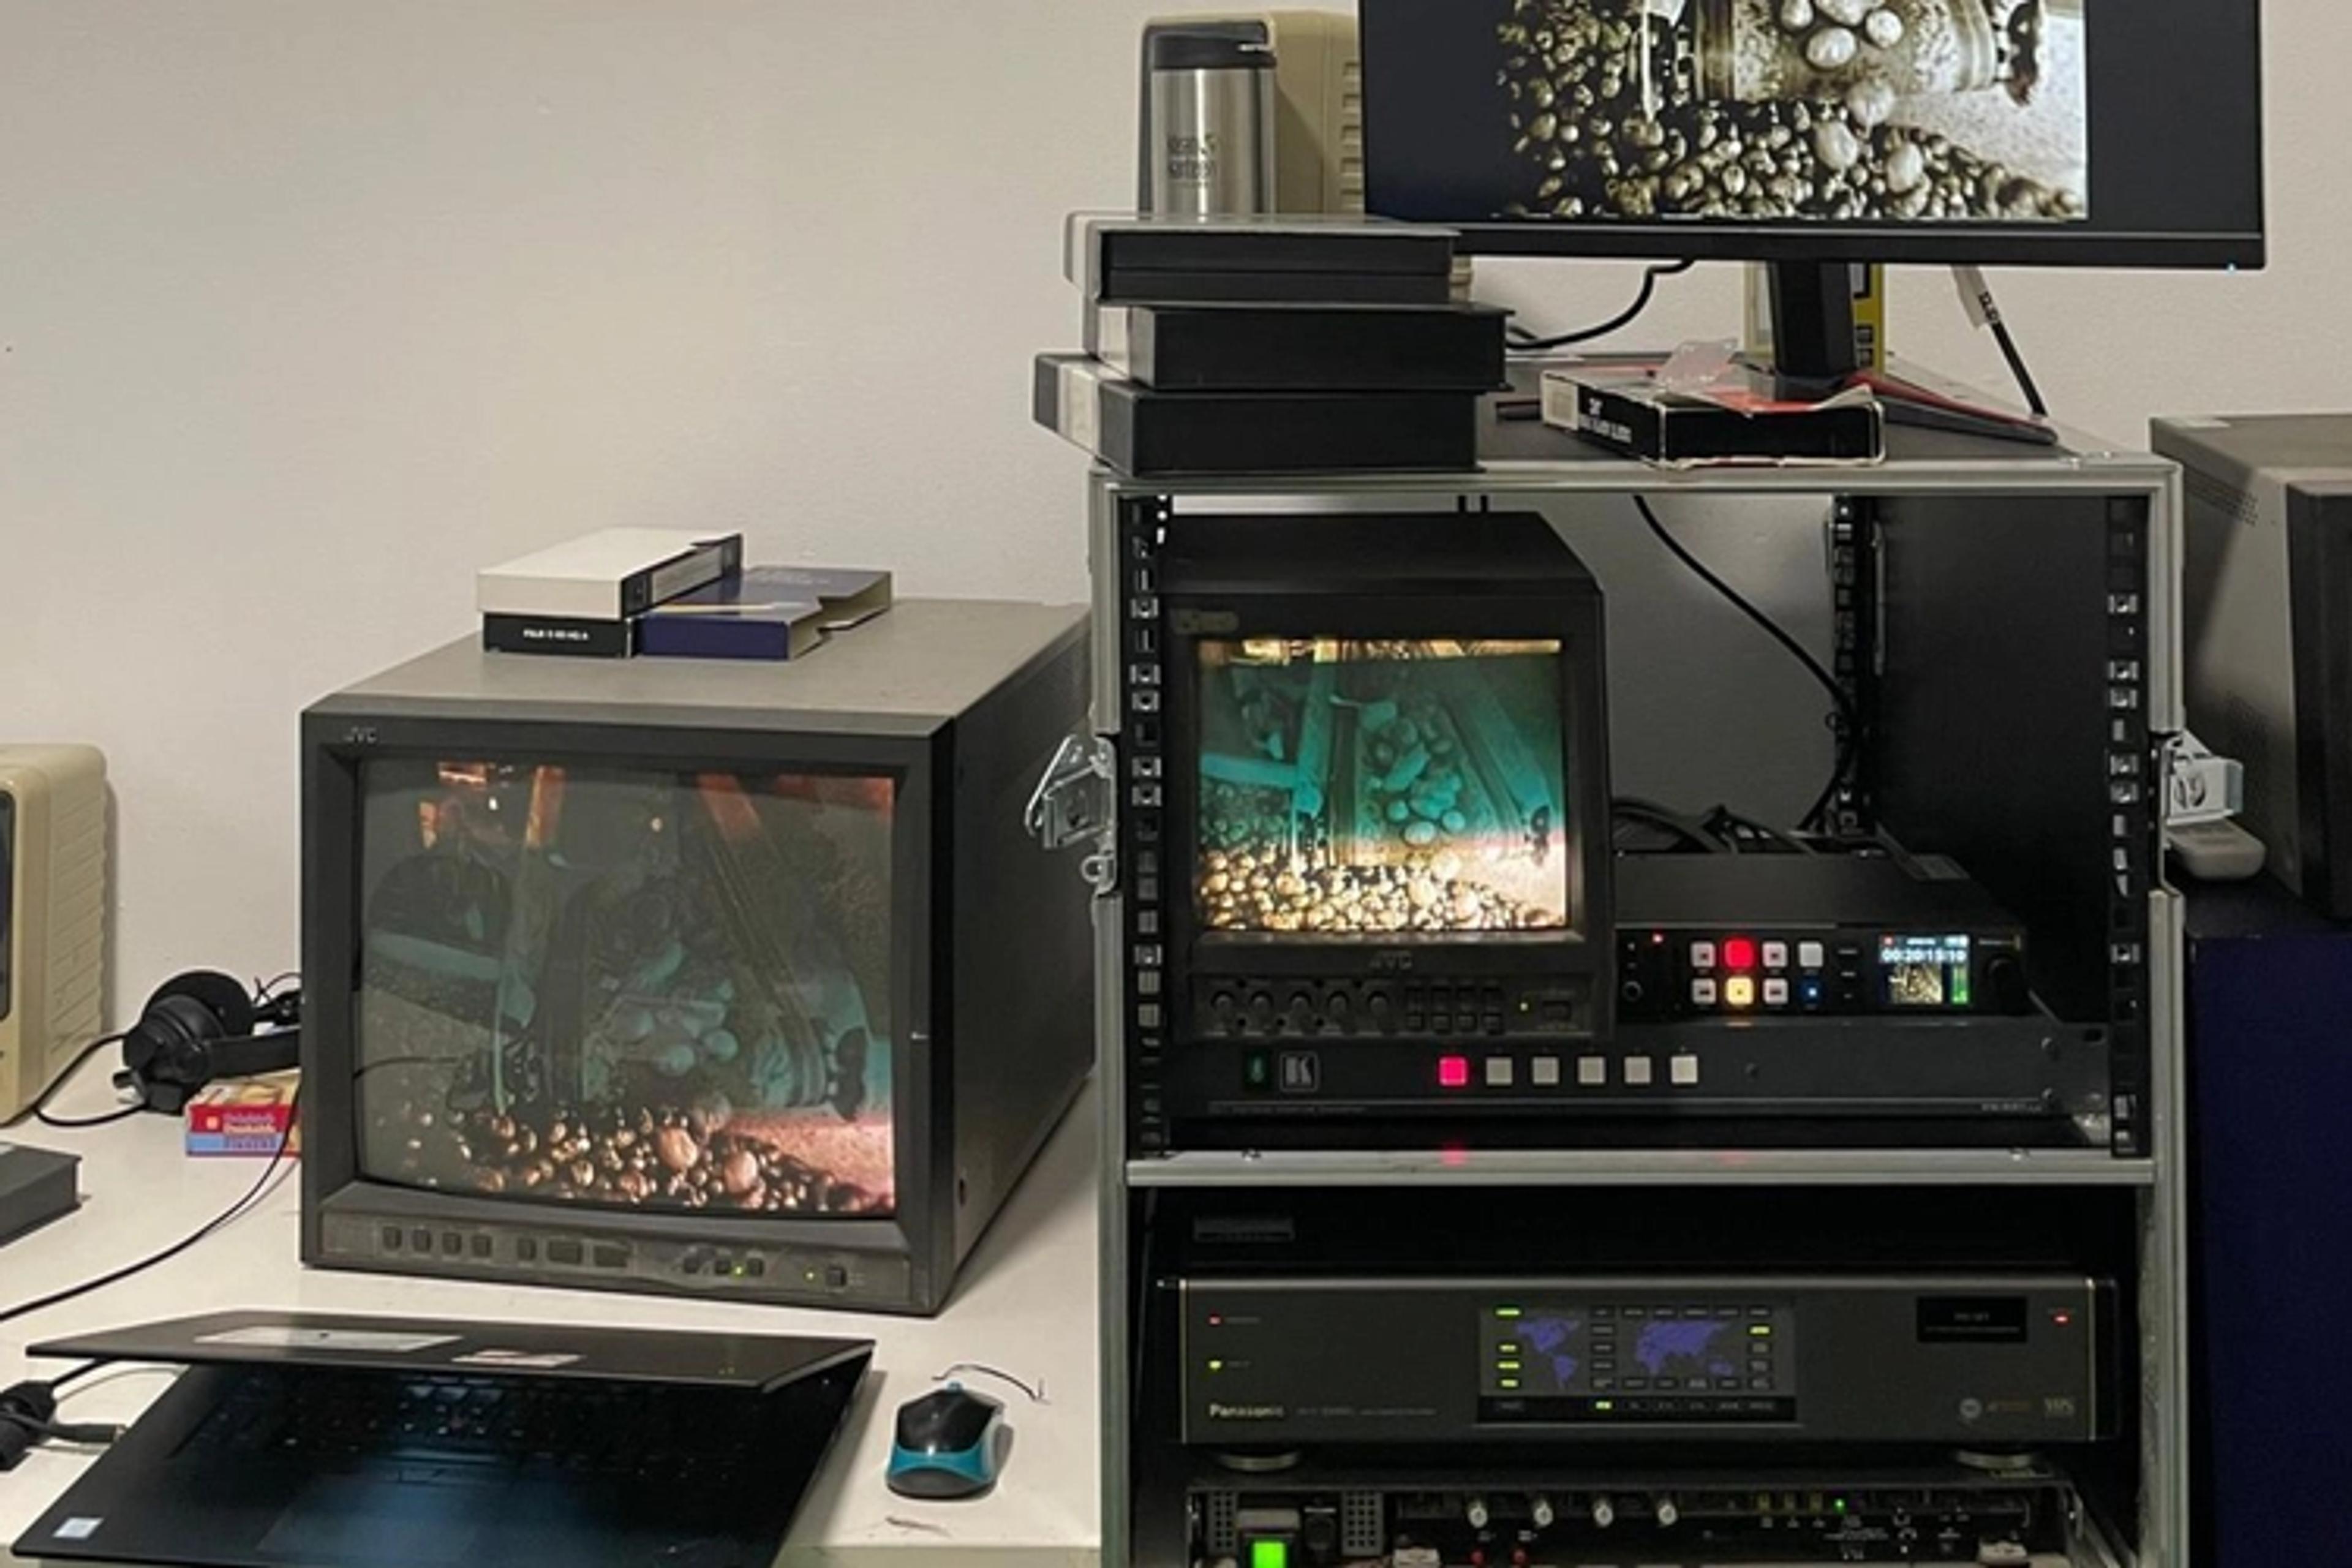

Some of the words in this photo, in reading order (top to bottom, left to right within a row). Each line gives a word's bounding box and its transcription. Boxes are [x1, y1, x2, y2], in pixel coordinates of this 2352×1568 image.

[343, 726, 378, 744] JVC
[1370, 951, 1412, 969] JVC
[1210, 1403, 1284, 1418] Panasonic
